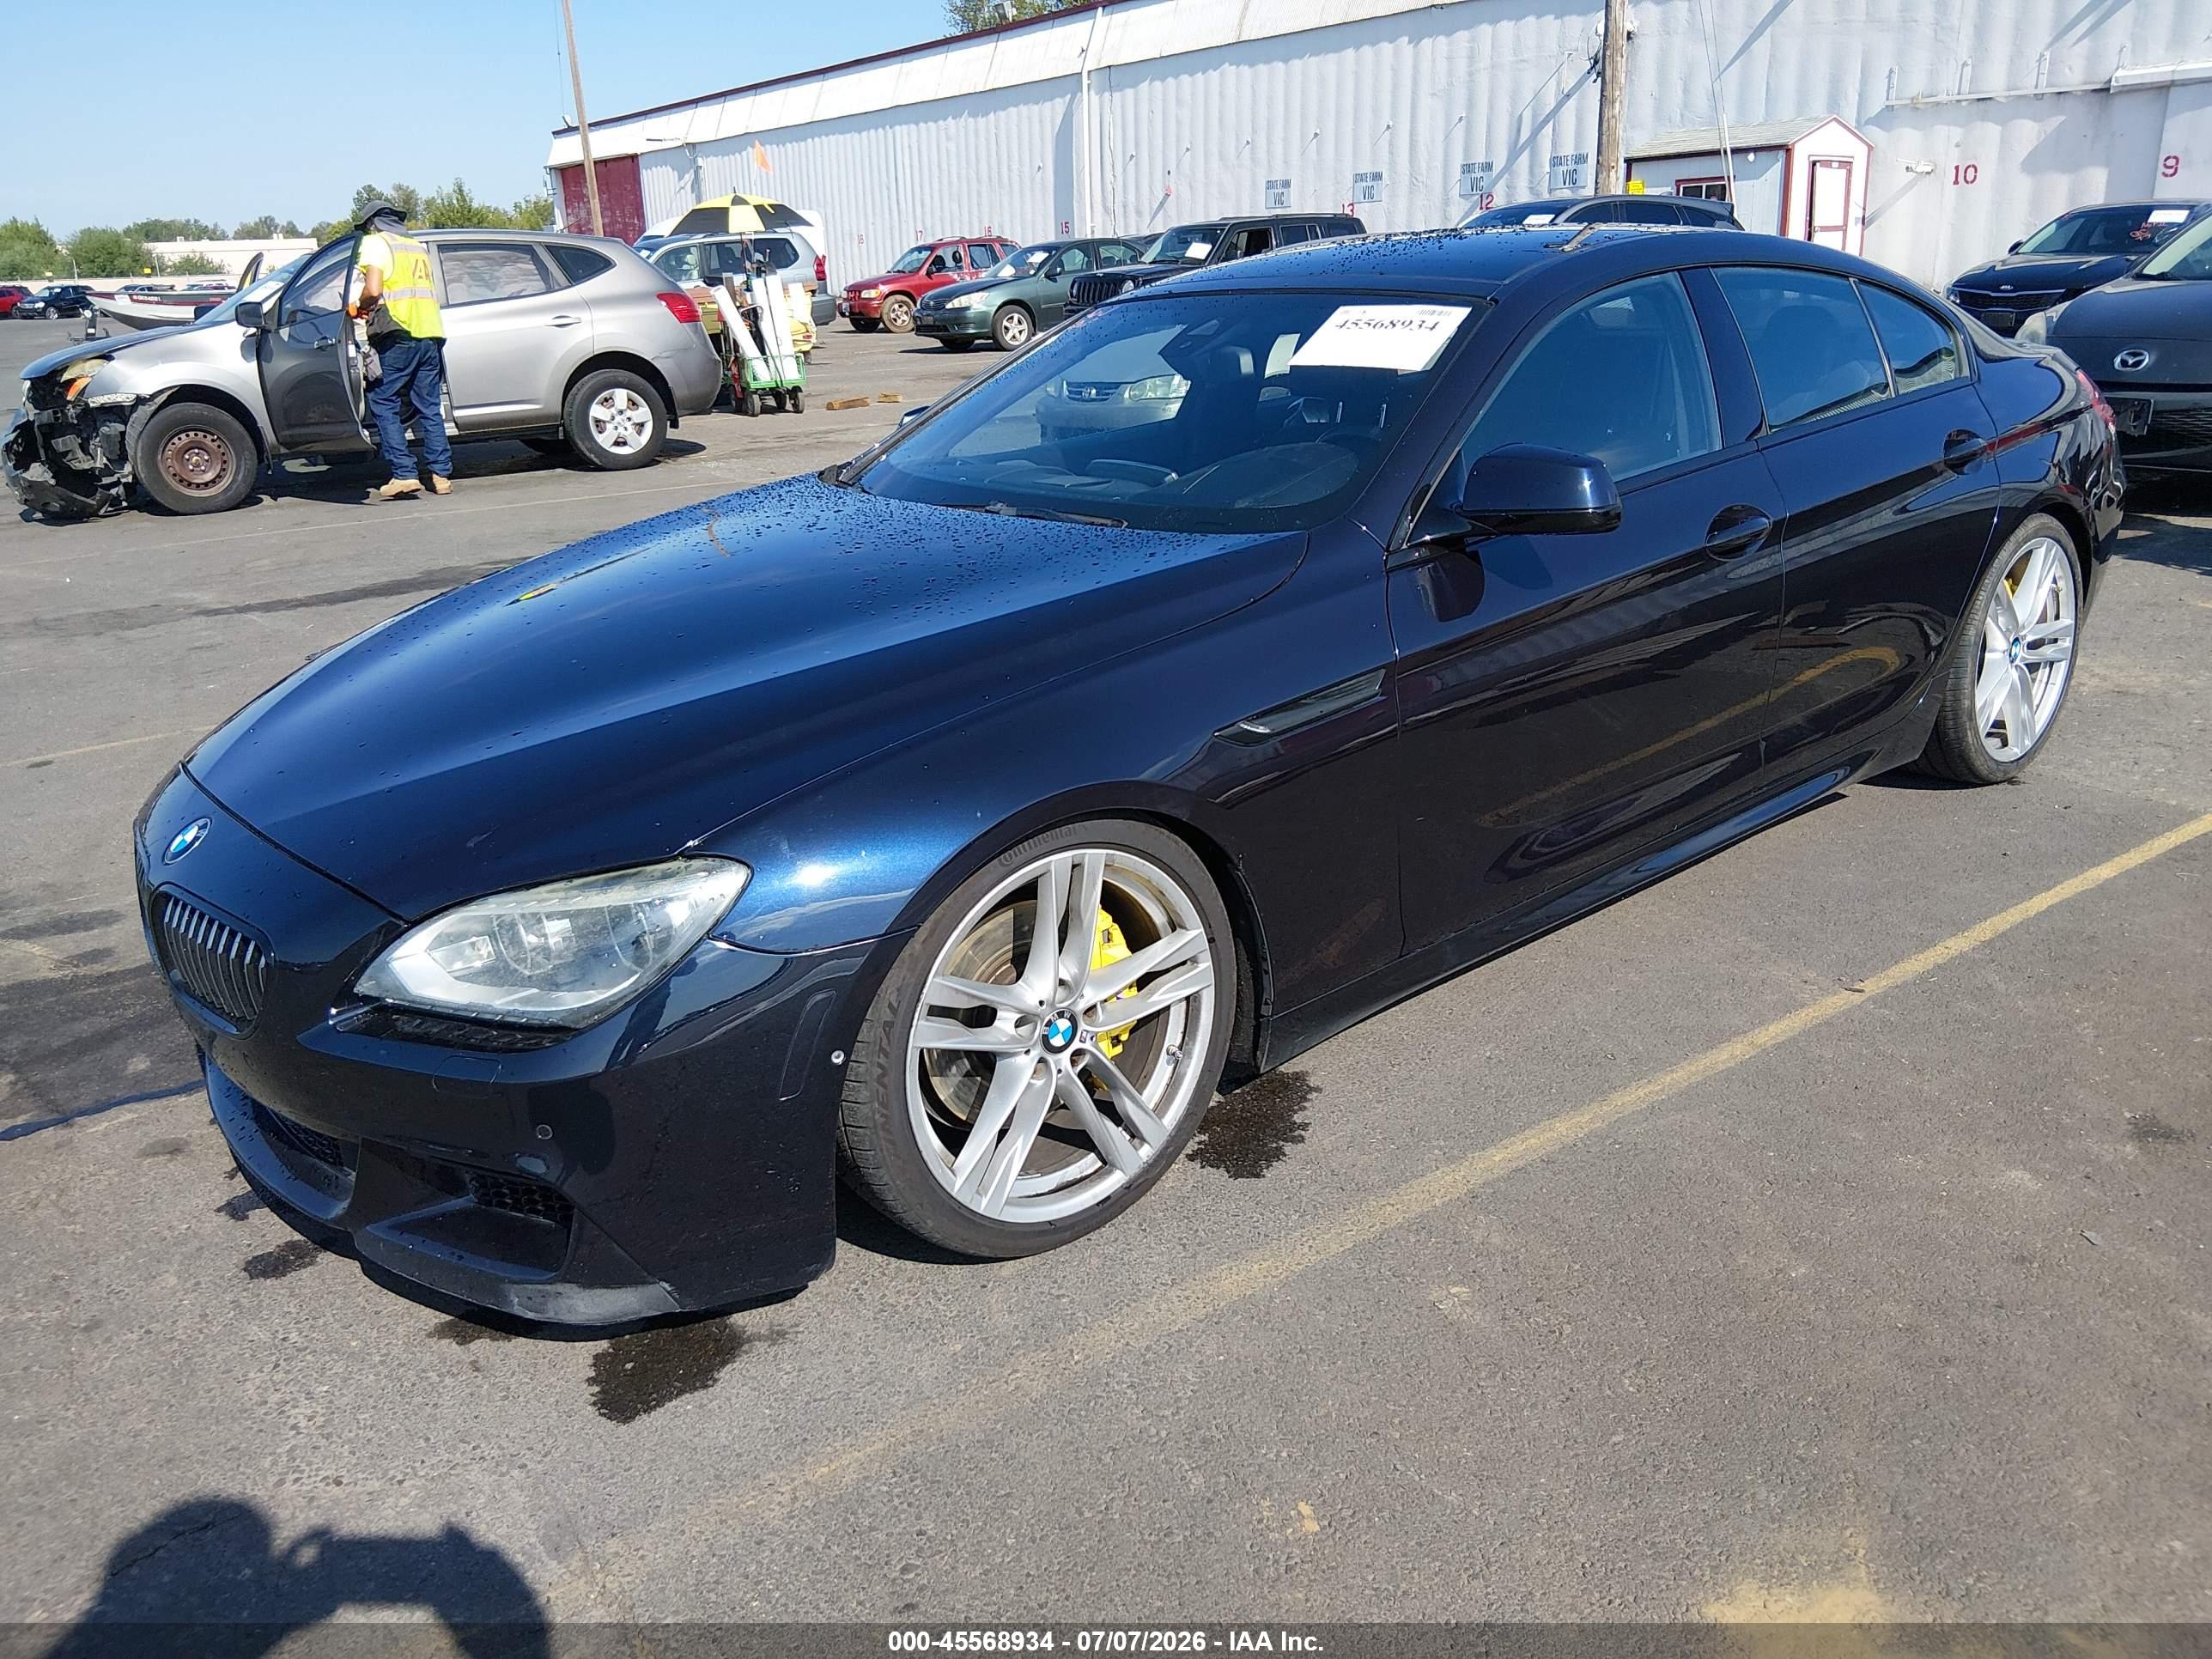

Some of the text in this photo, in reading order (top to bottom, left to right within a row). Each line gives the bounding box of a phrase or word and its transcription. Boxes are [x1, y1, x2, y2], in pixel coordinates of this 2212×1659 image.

[1552, 153, 1589, 167] STATE FARM
[2161, 155, 2179, 178] 9
[1462, 161, 1493, 174] STATE FARM
[1953, 164, 1978, 185] 10
[1354, 172, 1382, 183] STATE FARM
[1470, 176, 1484, 192] VIC
[1562, 168, 1577, 186] VIC
[1267, 179, 1291, 191] STATE FARM
[1273, 192, 1285, 206] VIC
[1362, 185, 1375, 200] VIC
[1479, 193, 1494, 210] 12
[1341, 203, 1354, 217] 13
[984, 226, 993, 237] 16
[1060, 222, 1070, 234] 15
[915, 230, 924, 241] 17
[1335, 319, 1440, 331] 45568934
